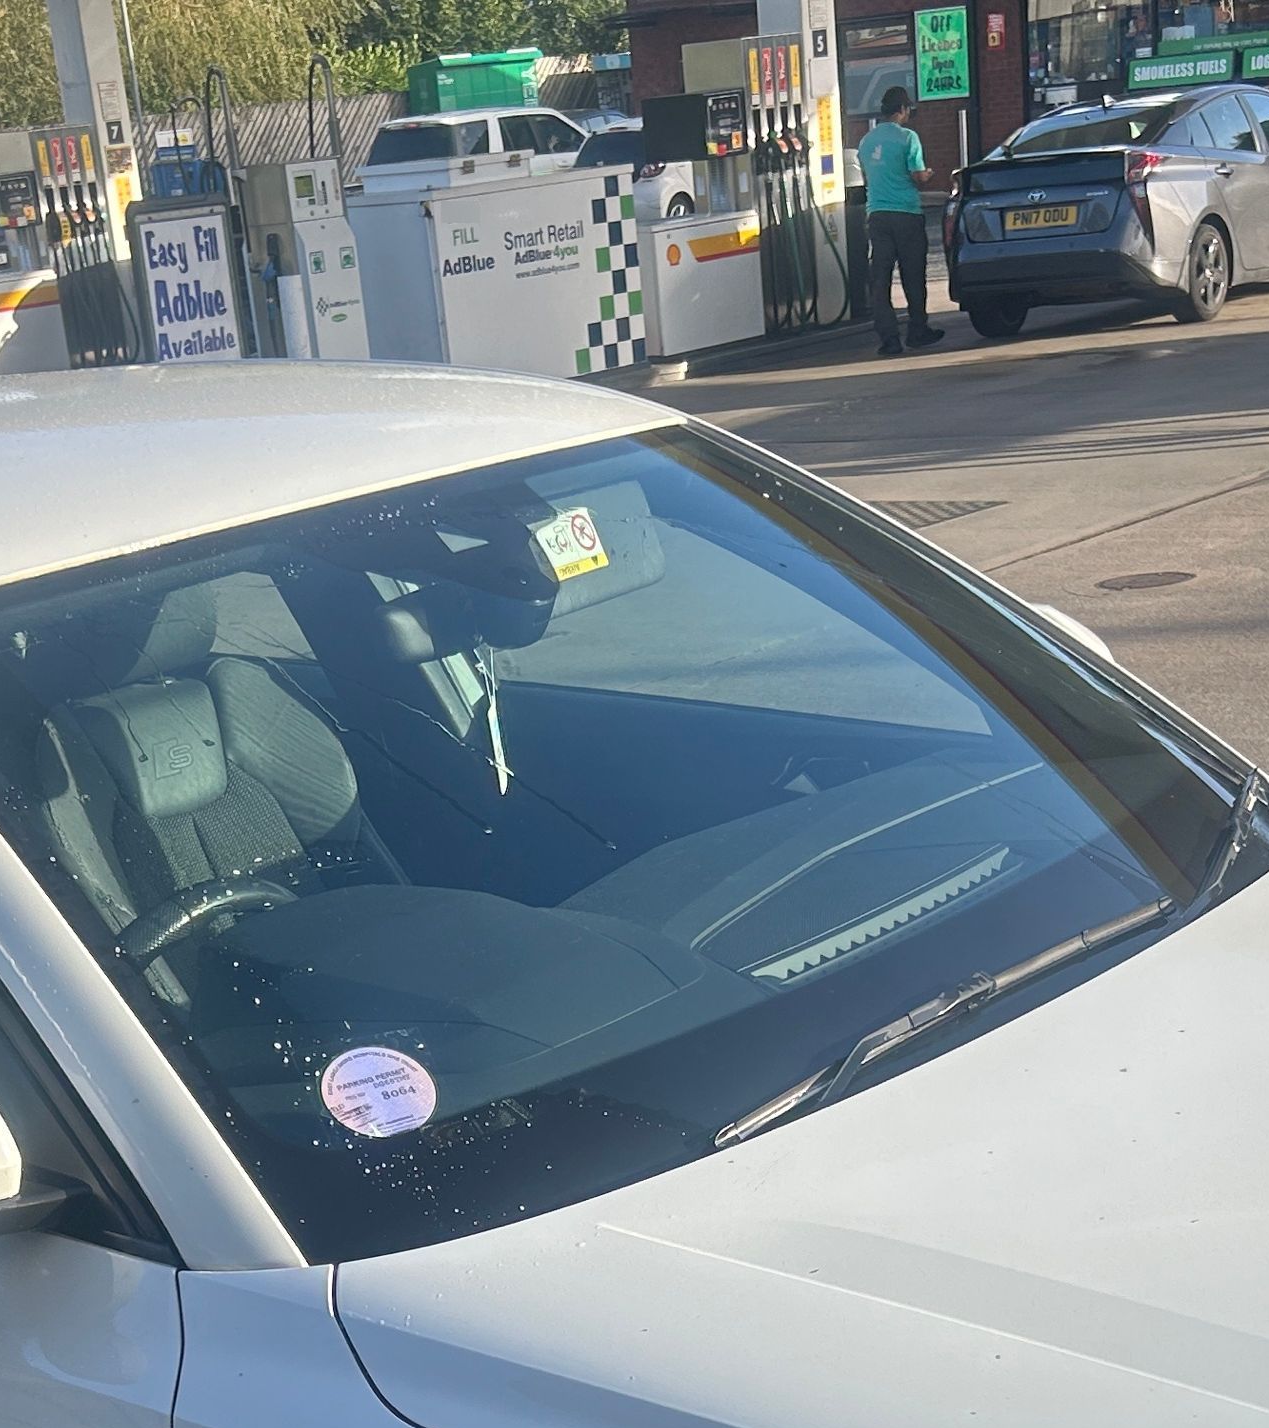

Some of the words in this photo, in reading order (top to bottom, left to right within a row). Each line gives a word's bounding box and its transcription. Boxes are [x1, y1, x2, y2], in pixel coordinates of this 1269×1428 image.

[817, 39, 824, 52] 5
[1134, 62, 1194, 82] SMOKELESS
[1196, 58, 1227, 76] FUELS
[110, 125, 119, 140] 7
[1013, 211, 1040, 226] PN17
[452, 227, 479, 246] FILL
[504, 227, 544, 250] Smart
[548, 220, 584, 243] Retail
[145, 231, 188, 273] Easy
[193, 226, 219, 262] Fill
[443, 255, 495, 277] AdBlue
[154, 280, 227, 326] Adblue
[158, 326, 236, 361] Available
[336, 1076, 374, 1092] PARKING
[375, 1067, 406, 1081] PERMIT
[381, 1085, 417, 1101] 8064
